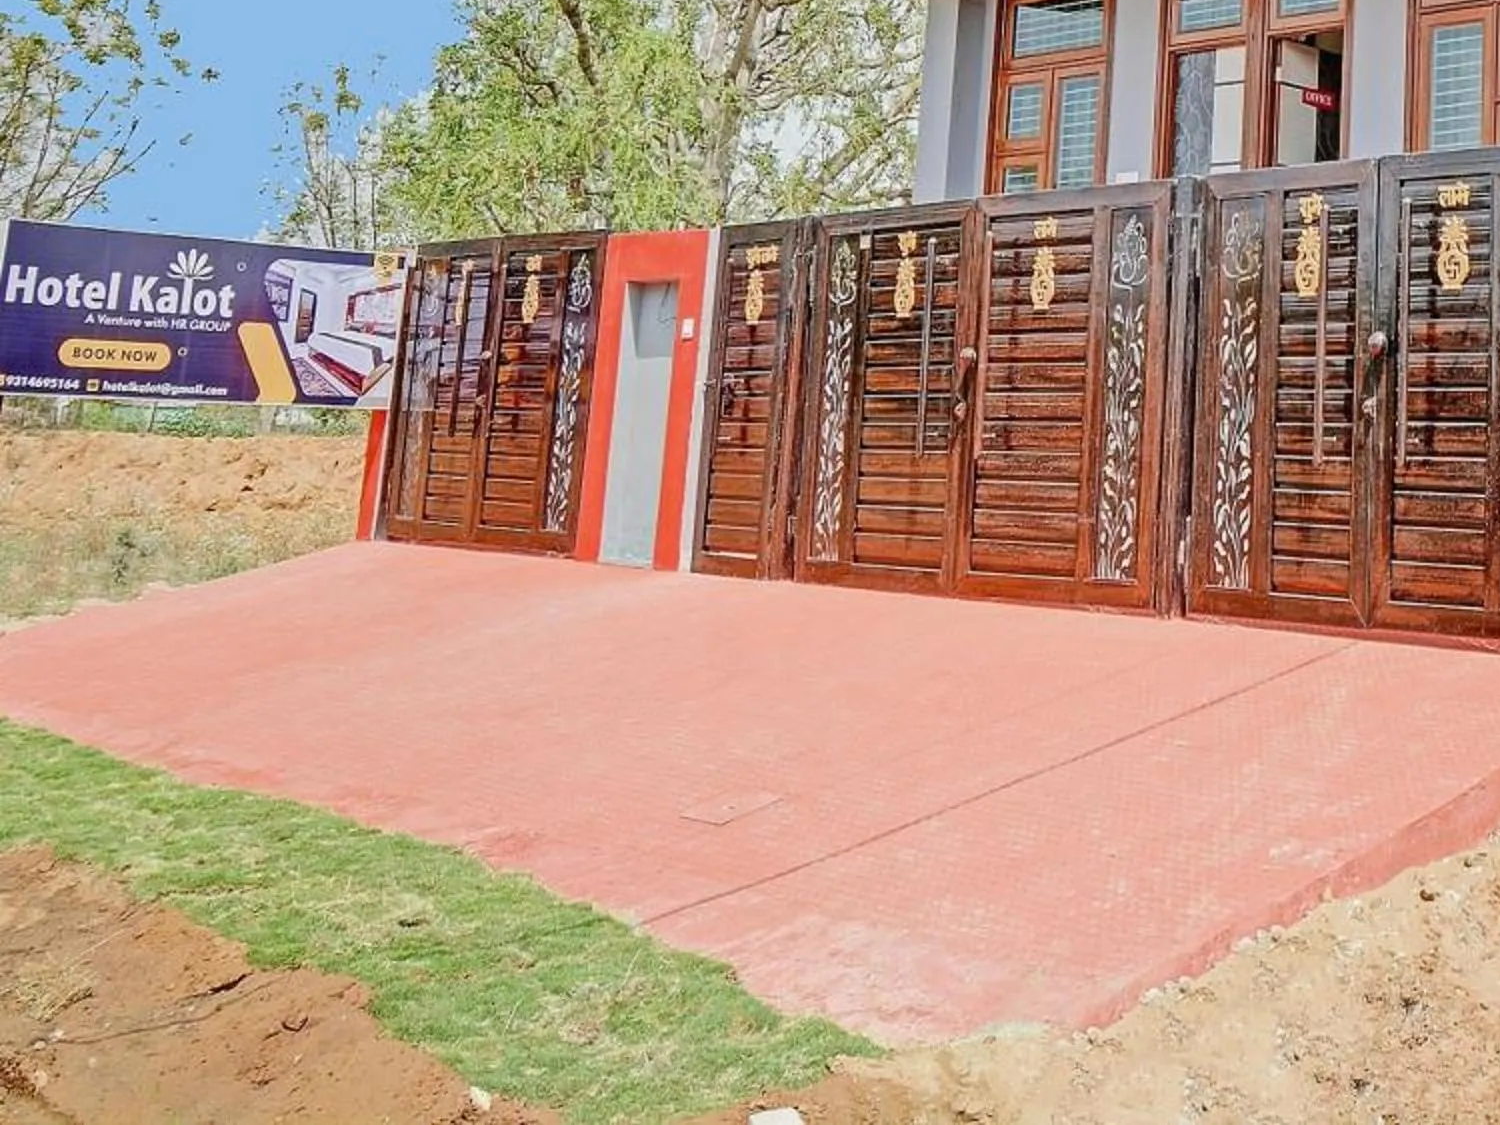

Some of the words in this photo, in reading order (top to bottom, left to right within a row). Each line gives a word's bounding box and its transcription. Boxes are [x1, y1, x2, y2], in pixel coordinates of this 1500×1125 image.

[4, 264, 122, 311] Hotel
[129, 275, 236, 318] Kalot
[84, 313, 95, 325] A
[98, 314, 142, 328] Venture
[144, 317, 169, 329] with
[171, 318, 188, 330] HR
[189, 320, 232, 332] GROUP
[72, 346, 116, 360] BOOK
[121, 350, 158, 362] NOW
